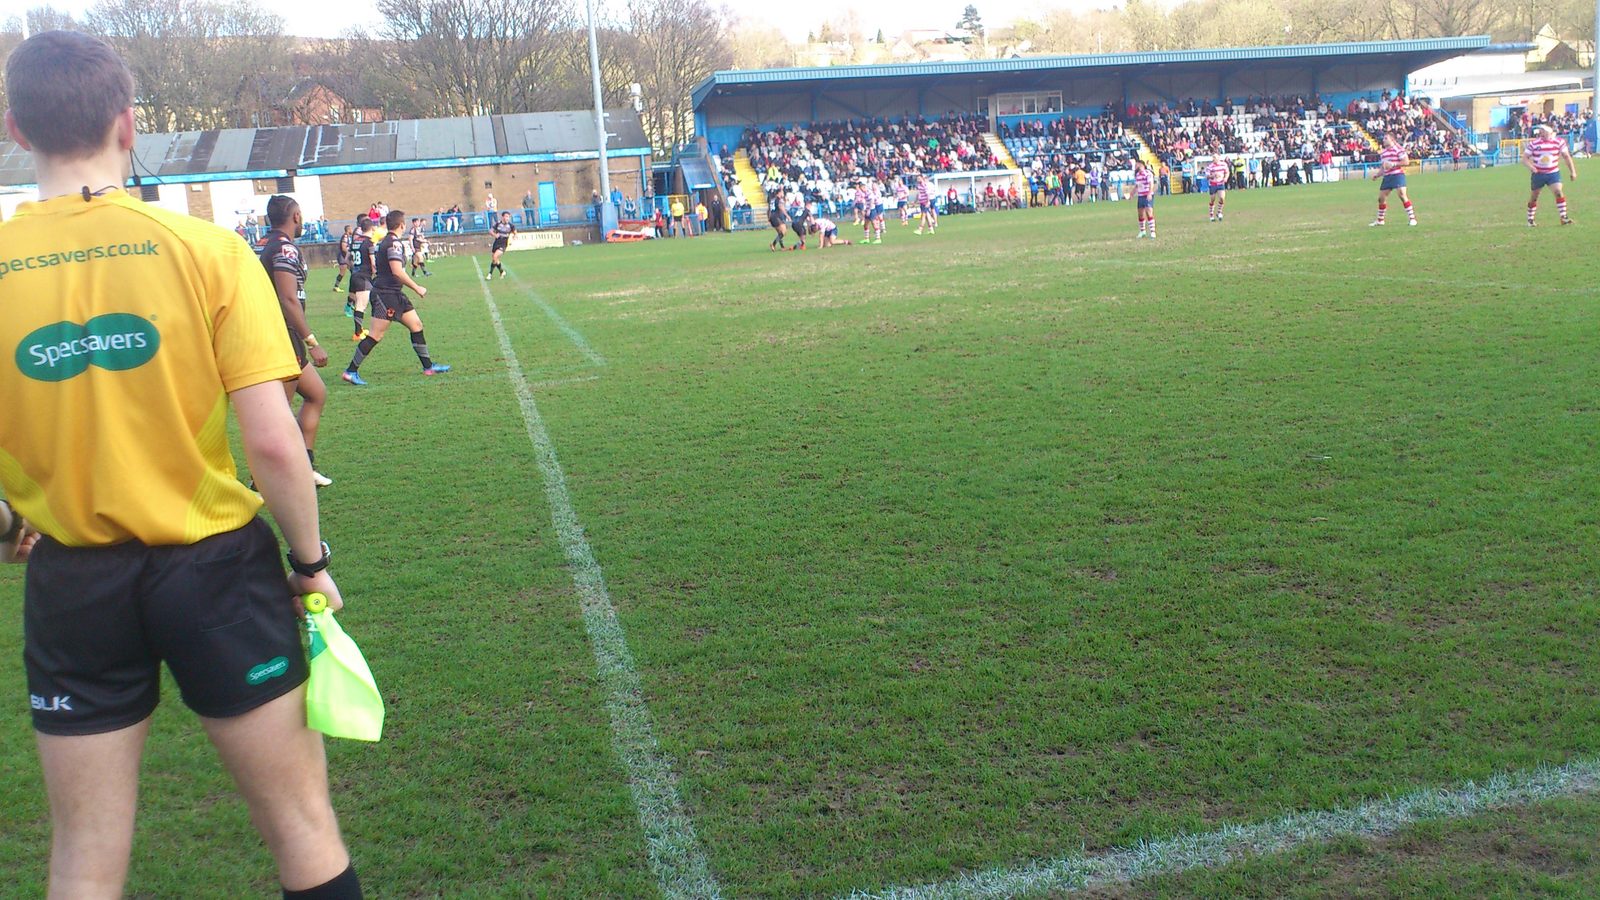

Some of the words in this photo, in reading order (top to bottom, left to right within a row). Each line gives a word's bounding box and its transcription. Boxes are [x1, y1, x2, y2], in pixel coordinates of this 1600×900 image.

[29, 332, 147, 367] Specsavers
[250, 660, 286, 681] Specsavers
[31, 694, 73, 711] BLK
